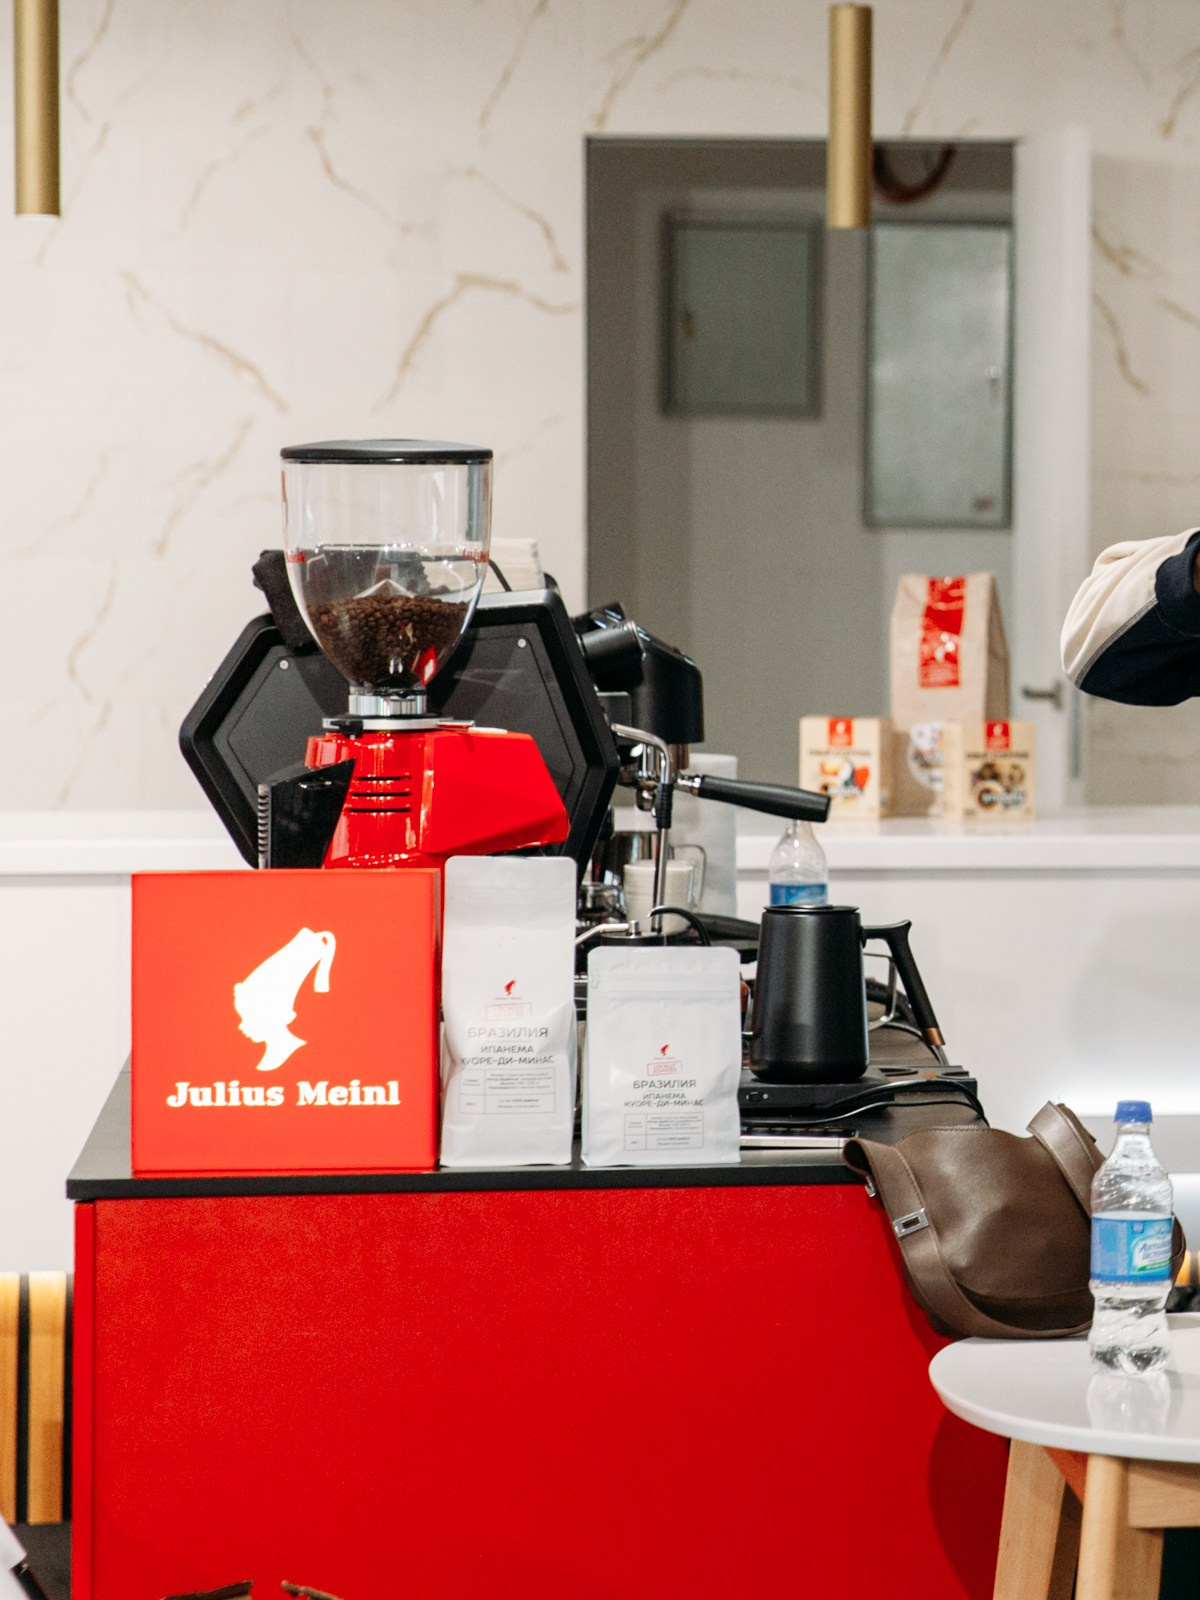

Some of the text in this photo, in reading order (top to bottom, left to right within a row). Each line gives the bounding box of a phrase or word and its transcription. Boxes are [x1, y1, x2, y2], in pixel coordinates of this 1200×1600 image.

[467, 1027, 549, 1038] БРАЗИЛИЯ
[481, 1045, 534, 1054] ИПАНЕМА
[633, 1079, 697, 1090] БРАЗИЛИЯ
[166, 1079, 401, 1107] Julius Meinl
[643, 1092, 686, 1100] ИПАНЕМА
